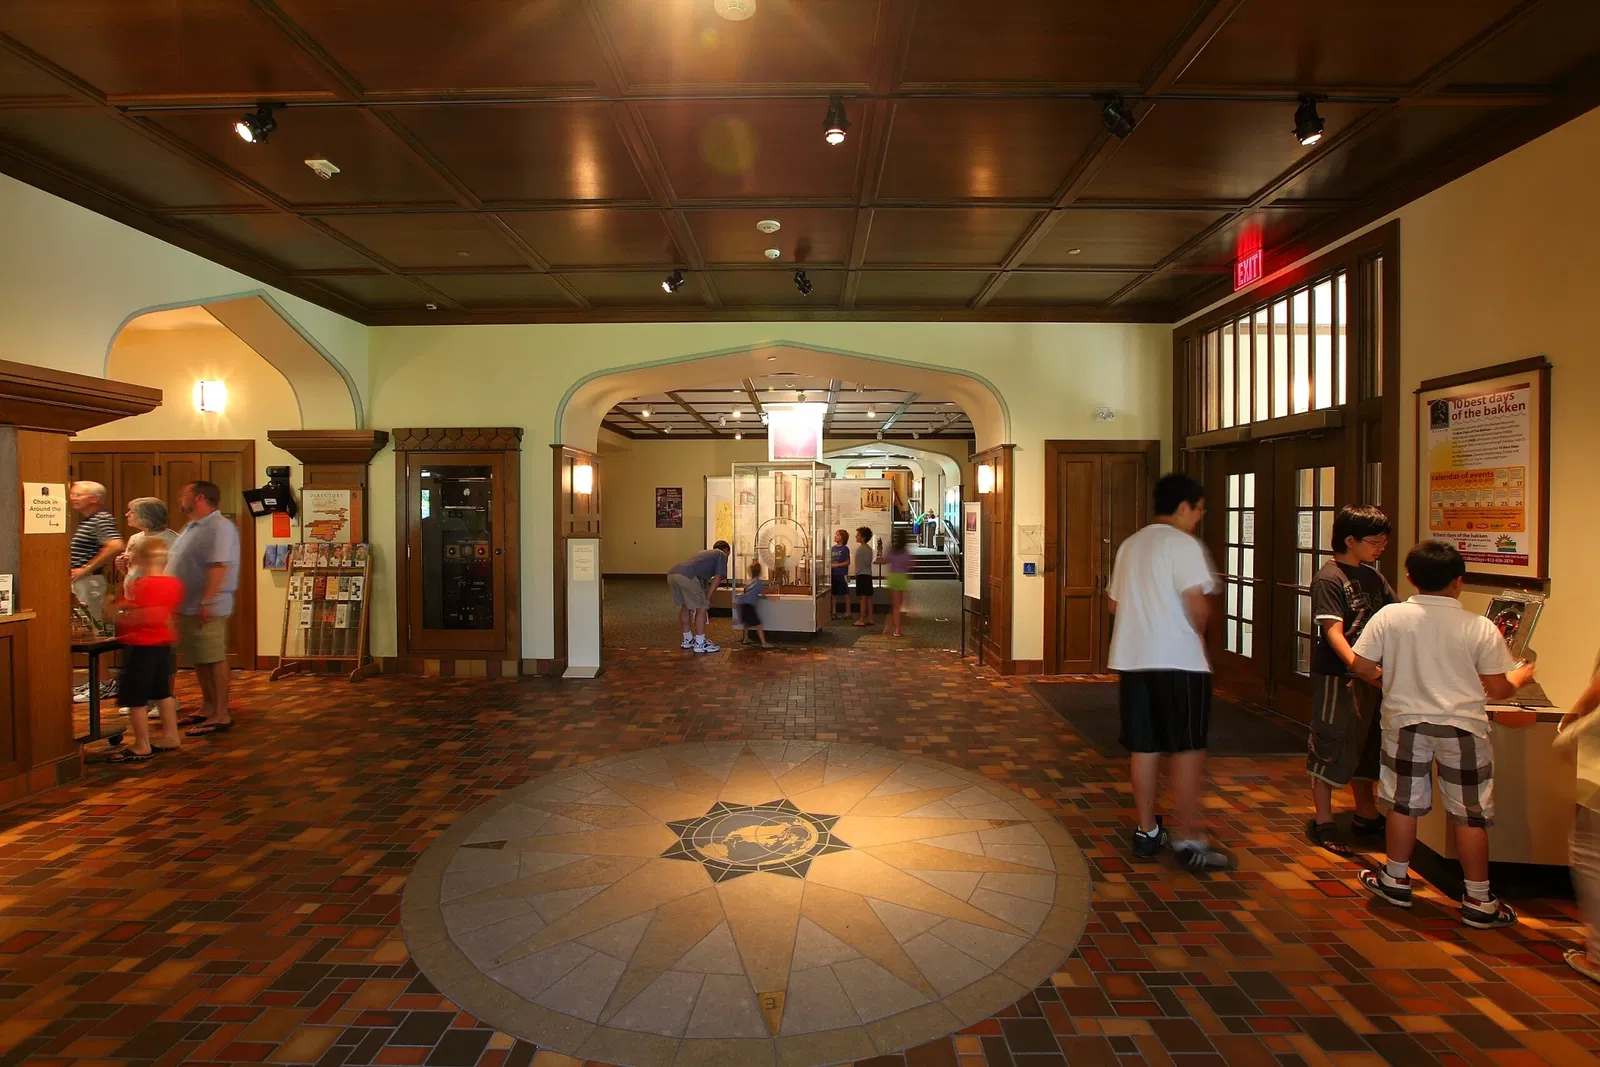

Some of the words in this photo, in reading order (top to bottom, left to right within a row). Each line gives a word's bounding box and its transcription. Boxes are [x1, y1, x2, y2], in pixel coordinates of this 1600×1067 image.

[1238, 253, 1258, 286] EXIT
[1452, 399, 1463, 410] 10
[1464, 397, 1487, 408] best
[1489, 392, 1515, 405] days
[1452, 410, 1462, 421] of
[1464, 408, 1482, 419] the
[1484, 402, 1526, 416] bakken
[1431, 473, 1460, 481] calendar
[1469, 471, 1494, 479] events
